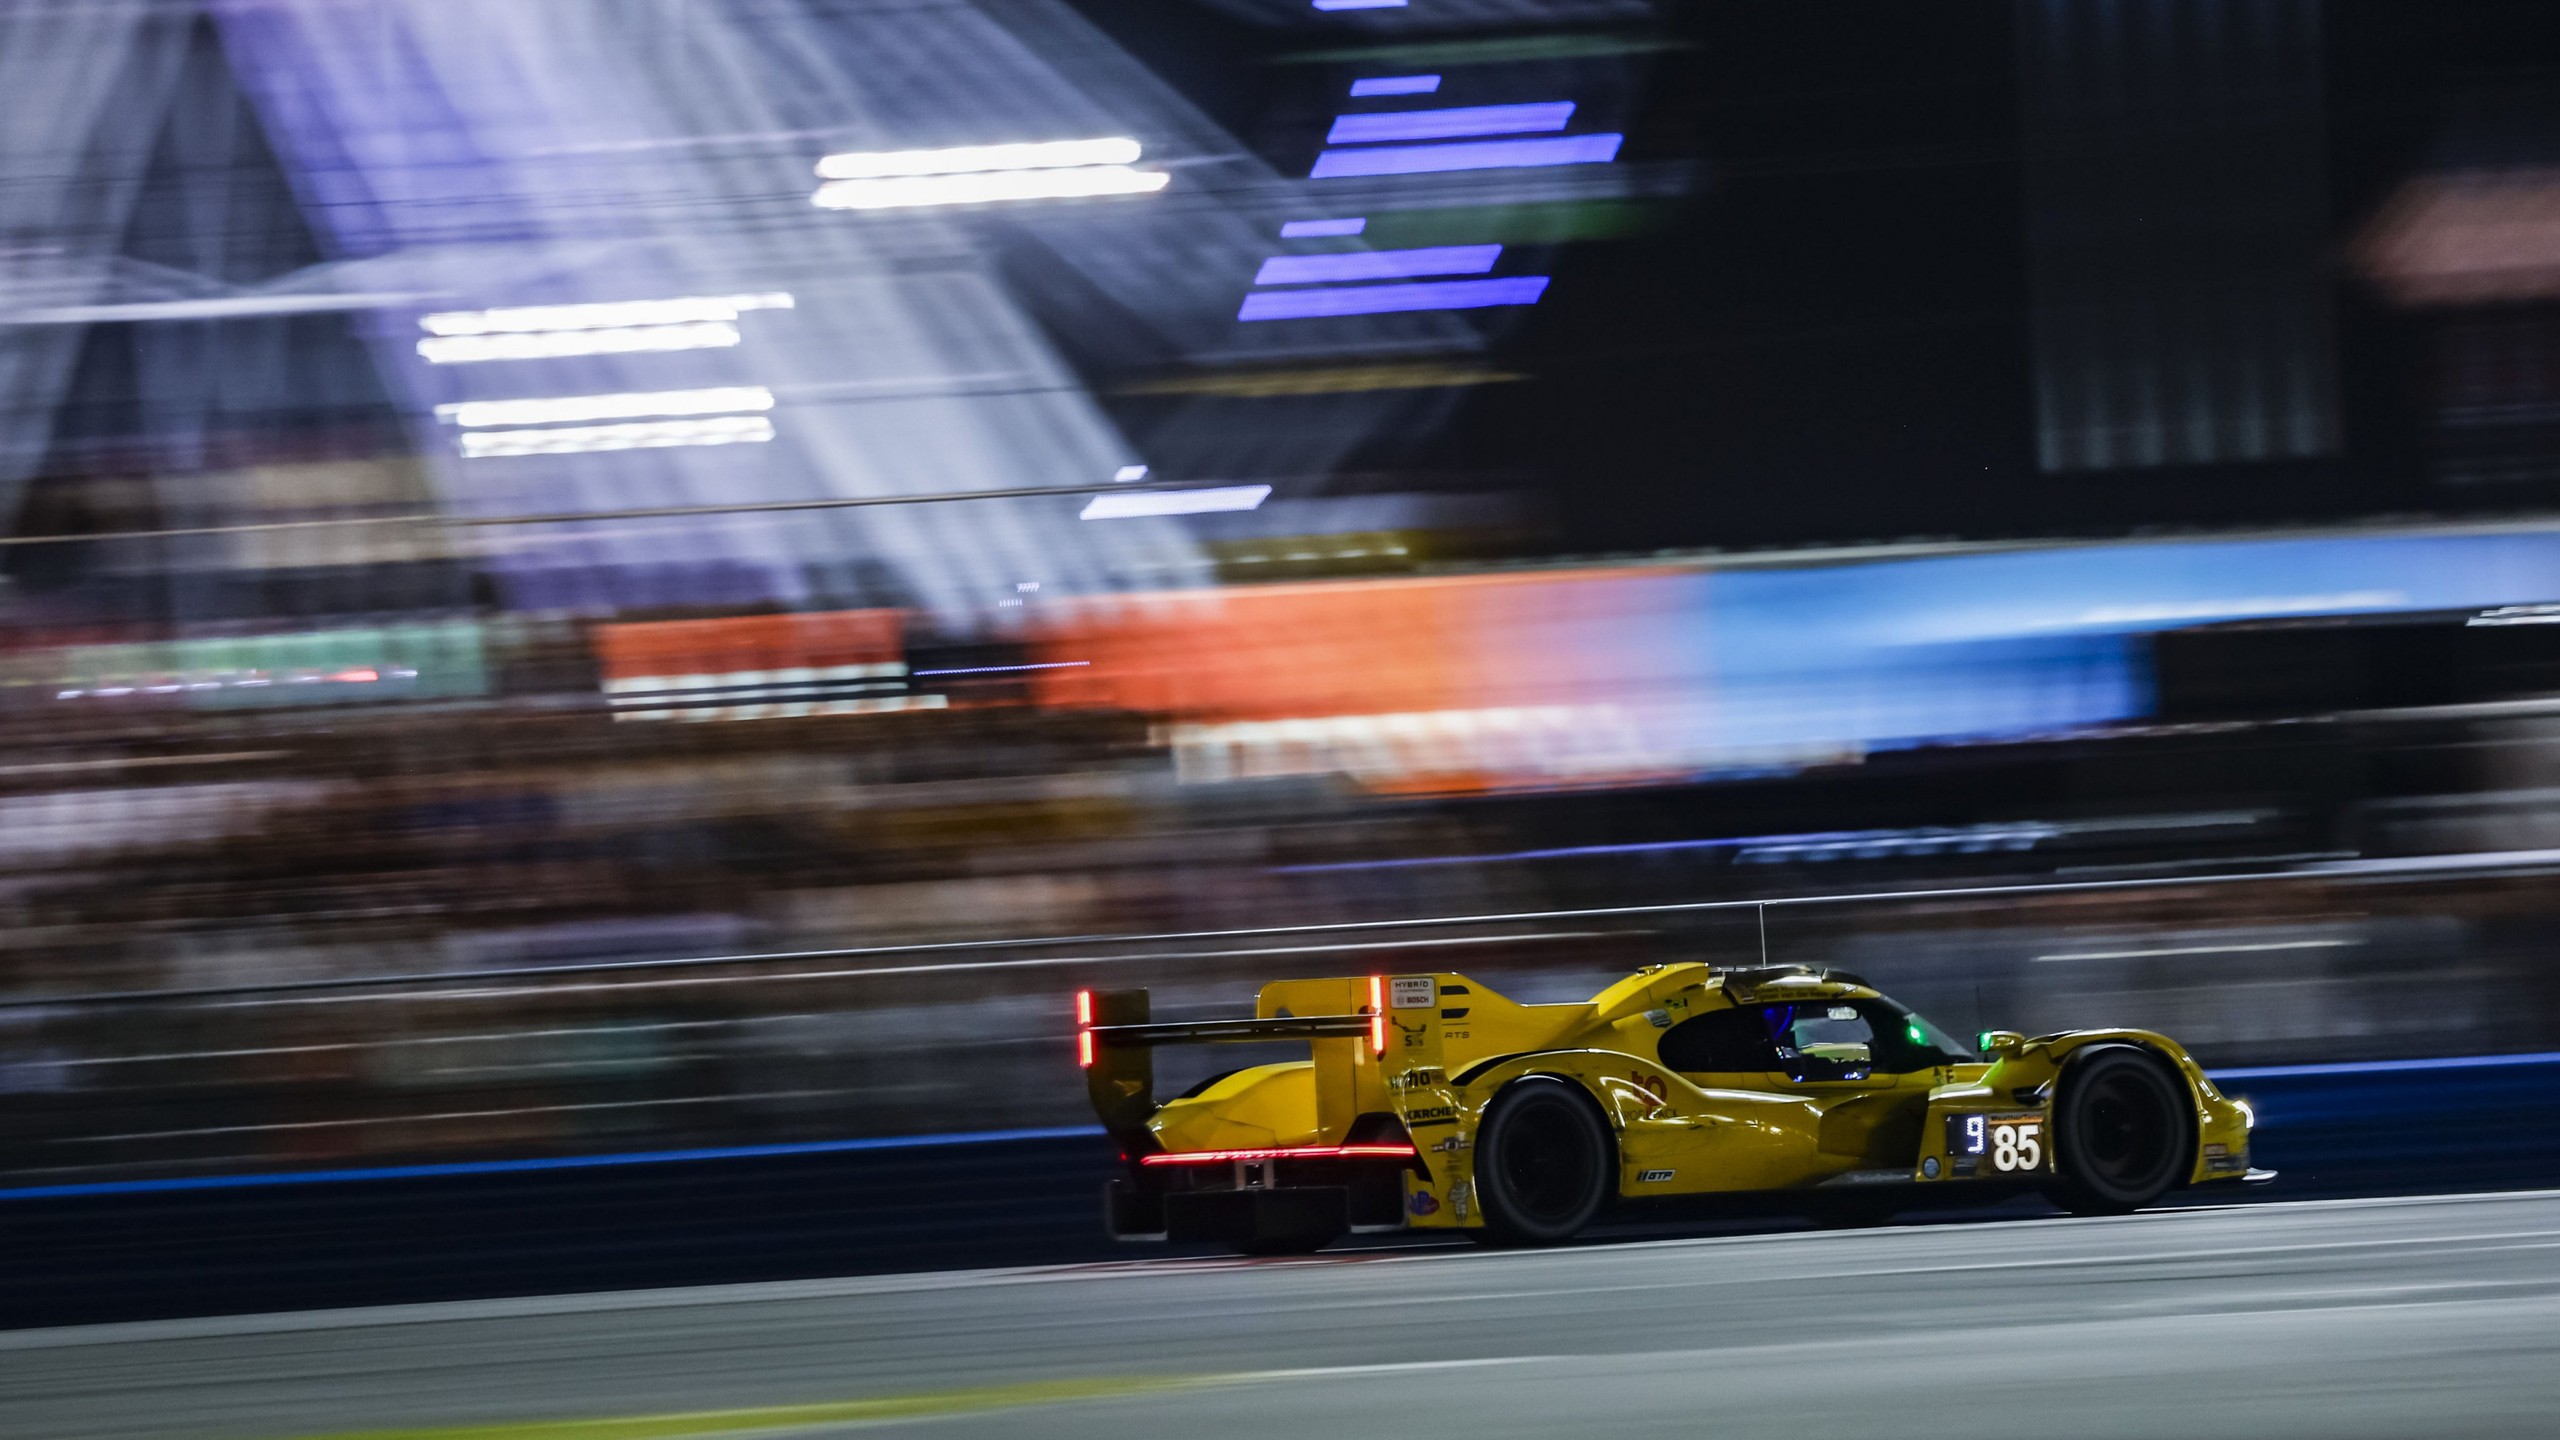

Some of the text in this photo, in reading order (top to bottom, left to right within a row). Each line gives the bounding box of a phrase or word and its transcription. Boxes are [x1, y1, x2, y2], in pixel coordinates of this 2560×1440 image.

[1395, 981, 1429, 989] HYBRID
[1406, 996, 1429, 1004] BOSCH
[1966, 1116, 1984, 1152] 9
[1994, 1125, 2041, 1172] 85
[1648, 1171, 1673, 1180] GTP
